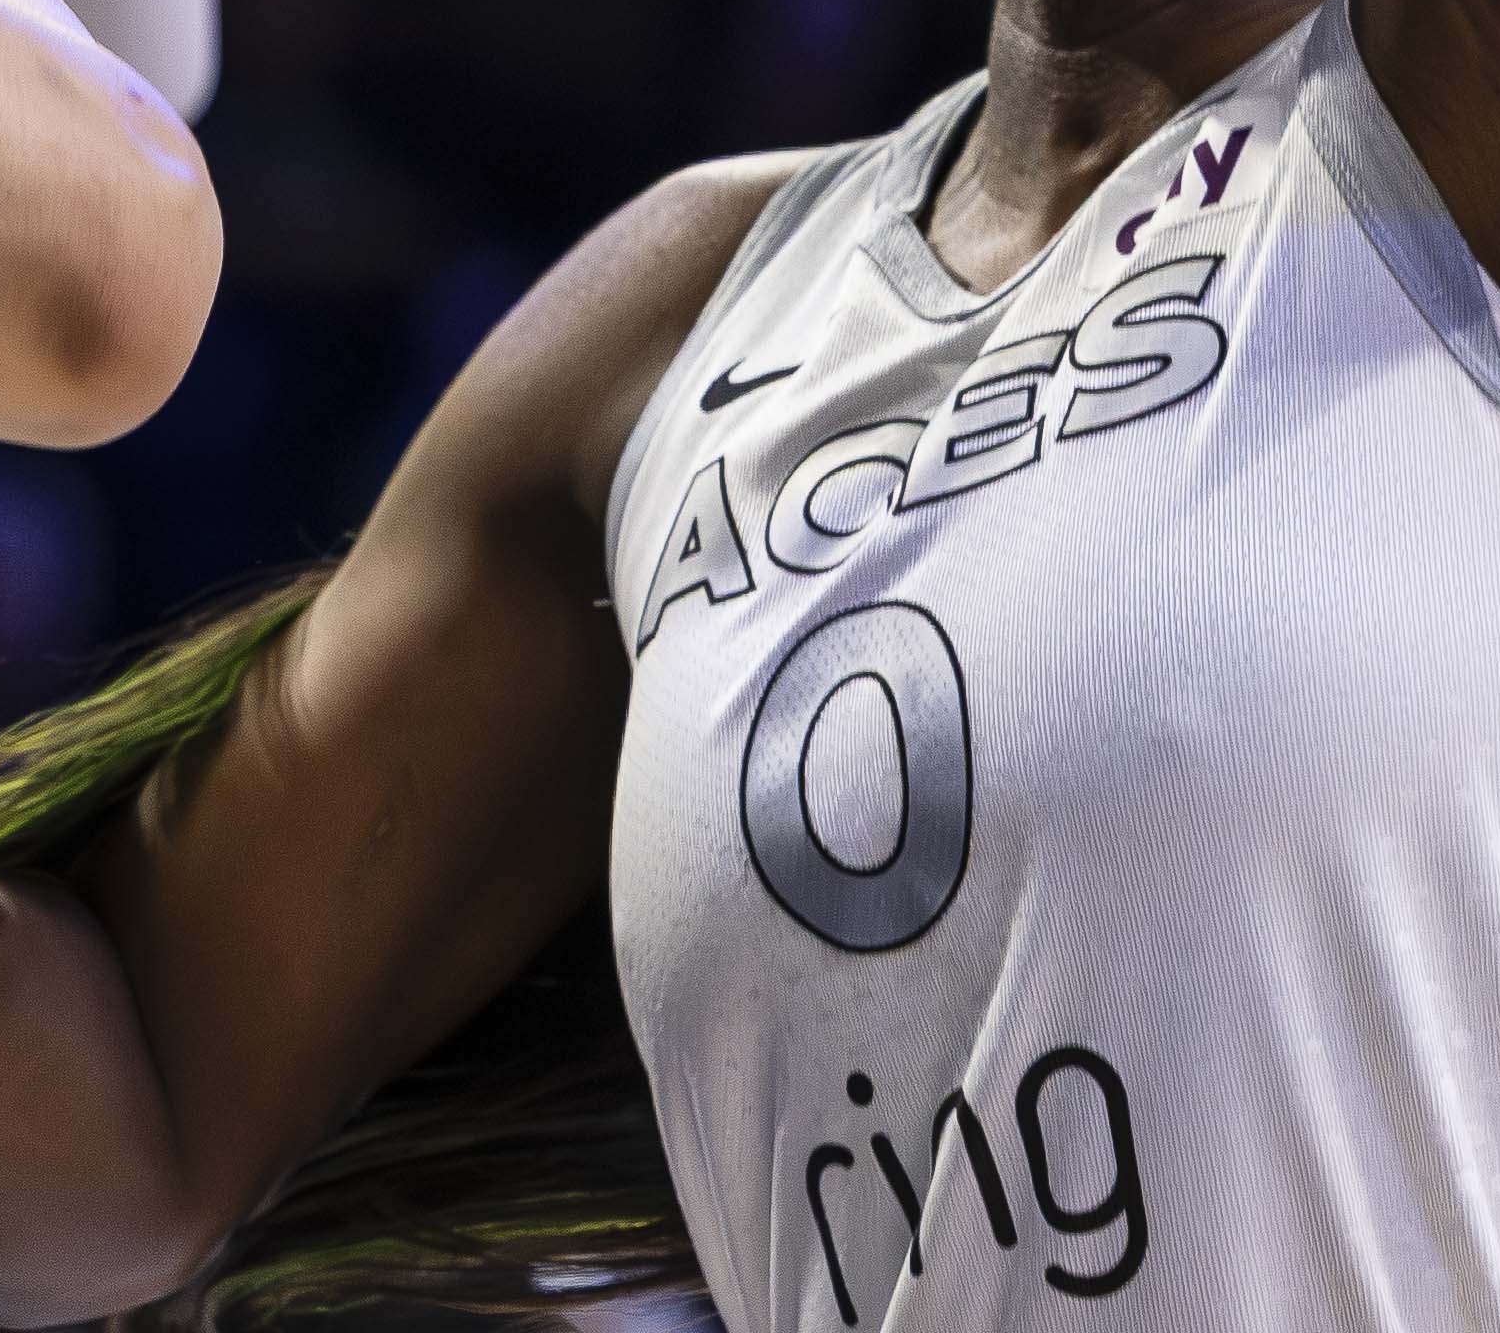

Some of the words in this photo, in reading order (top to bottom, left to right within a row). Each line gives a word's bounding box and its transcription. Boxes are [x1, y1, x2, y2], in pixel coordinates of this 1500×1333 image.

[636, 253, 1228, 660] ACES
[740, 600, 973, 953] 0
[802, 1044, 1149, 1328] ring
